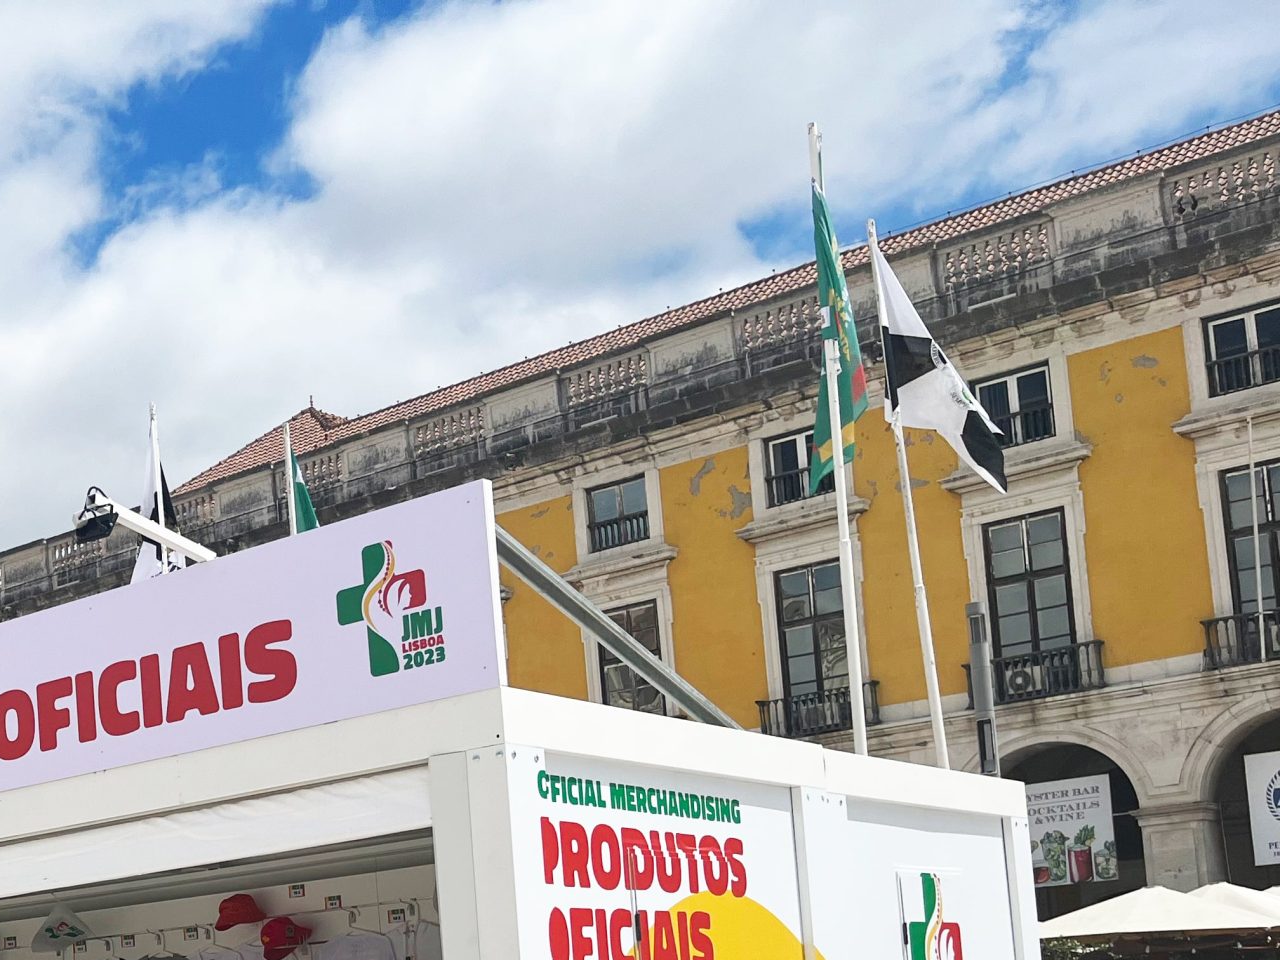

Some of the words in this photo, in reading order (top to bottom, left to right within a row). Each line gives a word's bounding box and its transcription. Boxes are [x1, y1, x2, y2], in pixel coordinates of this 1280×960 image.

[402, 606, 443, 642] JMJ
[402, 635, 444, 654] LISBOA
[403, 646, 446, 670] 2023
[609, 782, 741, 824] MERCHANDISING
[1026, 789, 1069, 802] YSTER
[1072, 785, 1100, 797] BAR
[1028, 800, 1100, 817] OCKTAILS
[540, 816, 747, 898] PRODUTOS
